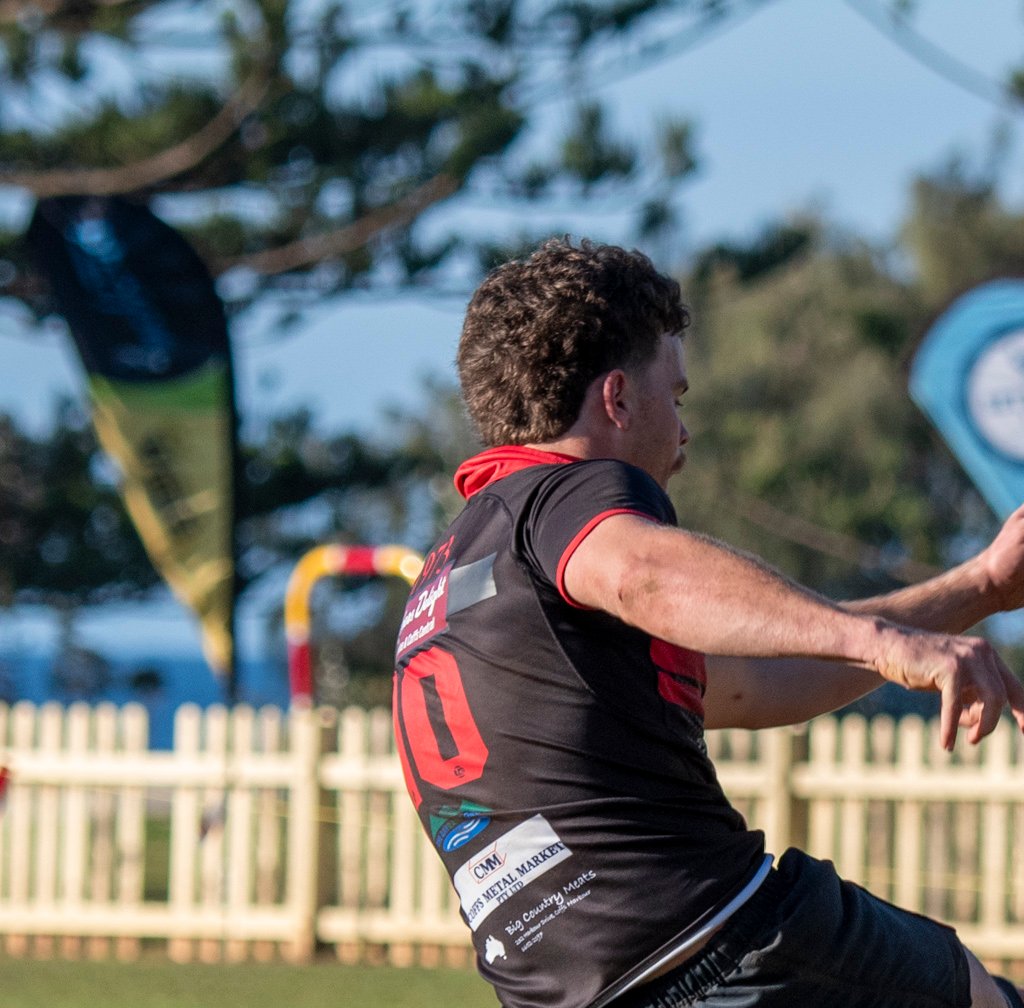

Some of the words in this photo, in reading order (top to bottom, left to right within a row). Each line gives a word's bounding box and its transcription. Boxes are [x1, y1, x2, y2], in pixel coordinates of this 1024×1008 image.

[473, 853, 502, 880] CMM
[482, 873, 518, 903] METAL
[509, 881, 524, 895] LTD
[504, 920, 524, 936] Big
[522, 891, 565, 922] Country
[562, 870, 597, 895] Meats
